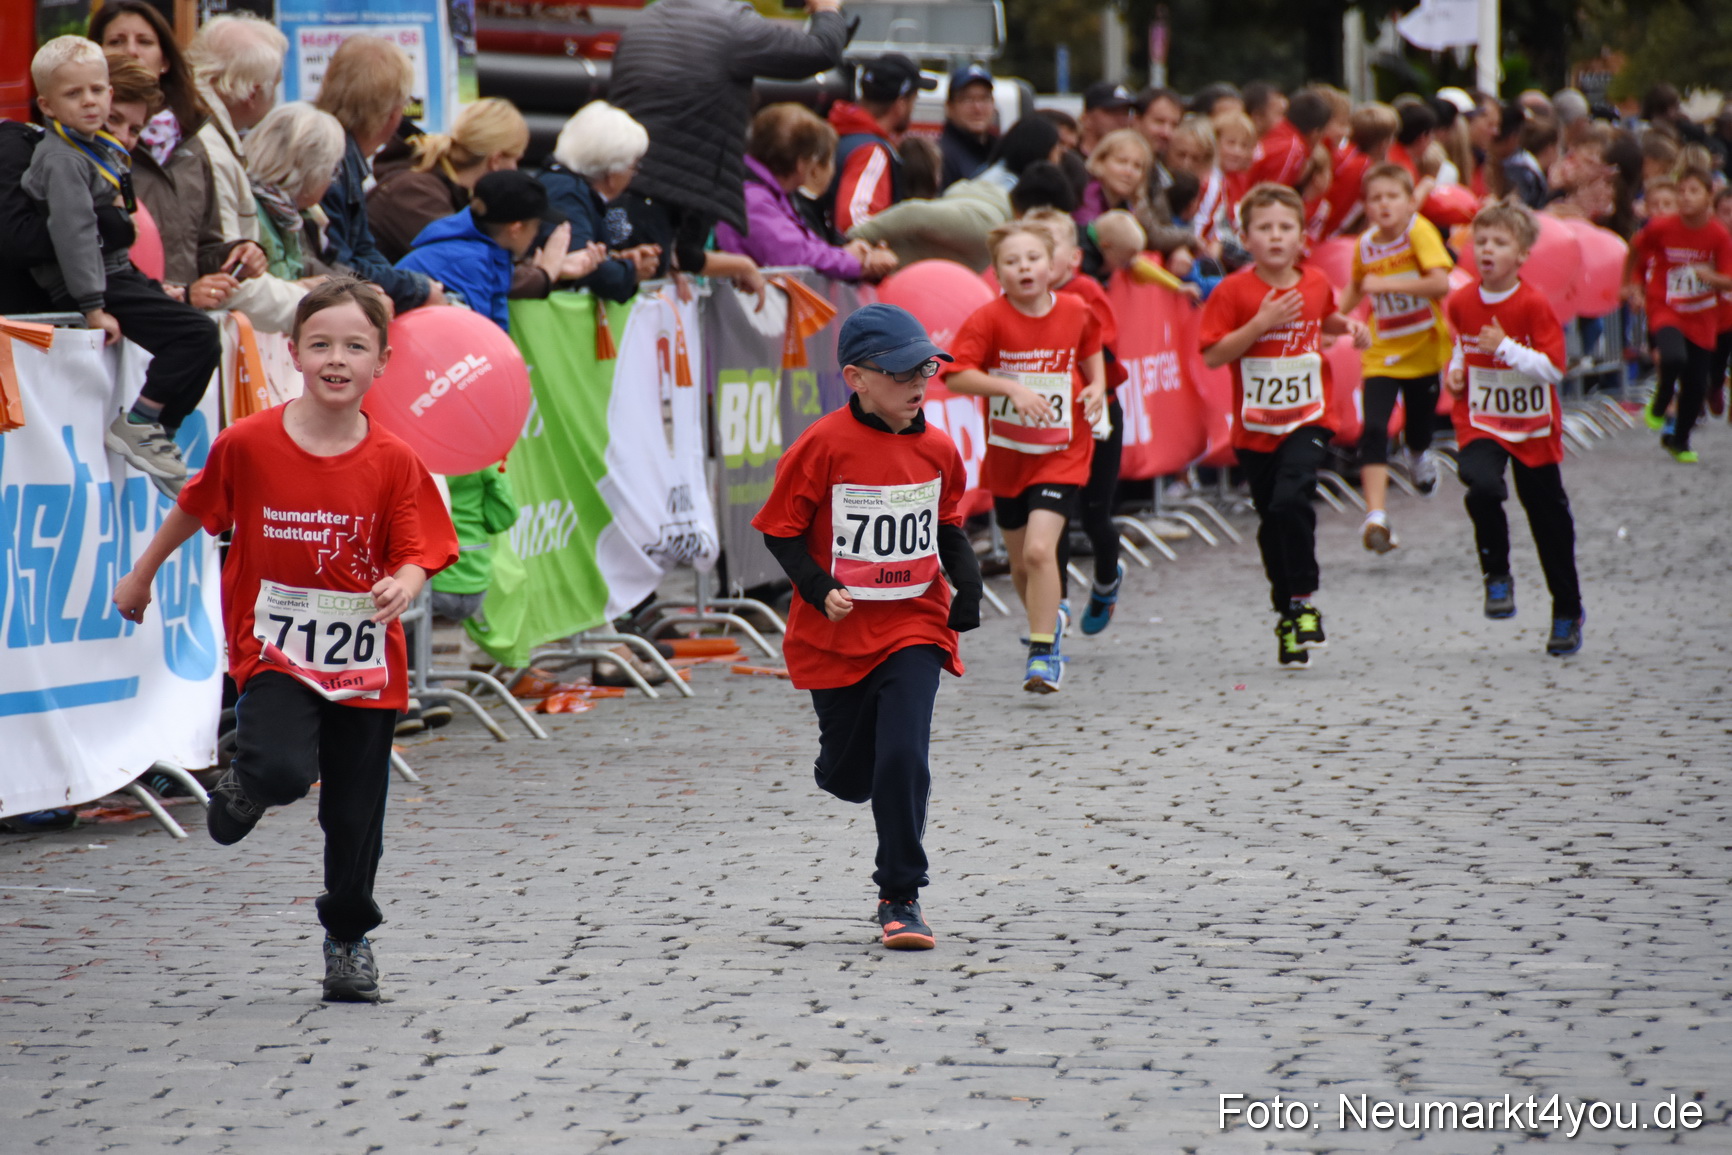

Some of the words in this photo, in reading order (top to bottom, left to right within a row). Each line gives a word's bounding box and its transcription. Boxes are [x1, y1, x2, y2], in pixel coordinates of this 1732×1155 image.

[999, 349, 1054, 360] Neumarkter
[1000, 360, 1043, 372] Stadtlauf
[410, 353, 488, 417] RÖDL
[457, 363, 493, 390] energie
[1251, 373, 1312, 404] 7251
[1478, 385, 1544, 413] 7080
[843, 497, 884, 506] NeuerMarkt
[890, 485, 936, 503] BOCK
[263, 506, 349, 525] Neumarkter
[263, 524, 331, 545] Stadtlauf
[846, 509, 932, 556] 7003
[875, 568, 912, 584] Jona
[267, 596, 310, 609] NeuerMarkt
[269, 613, 376, 665] 7126
